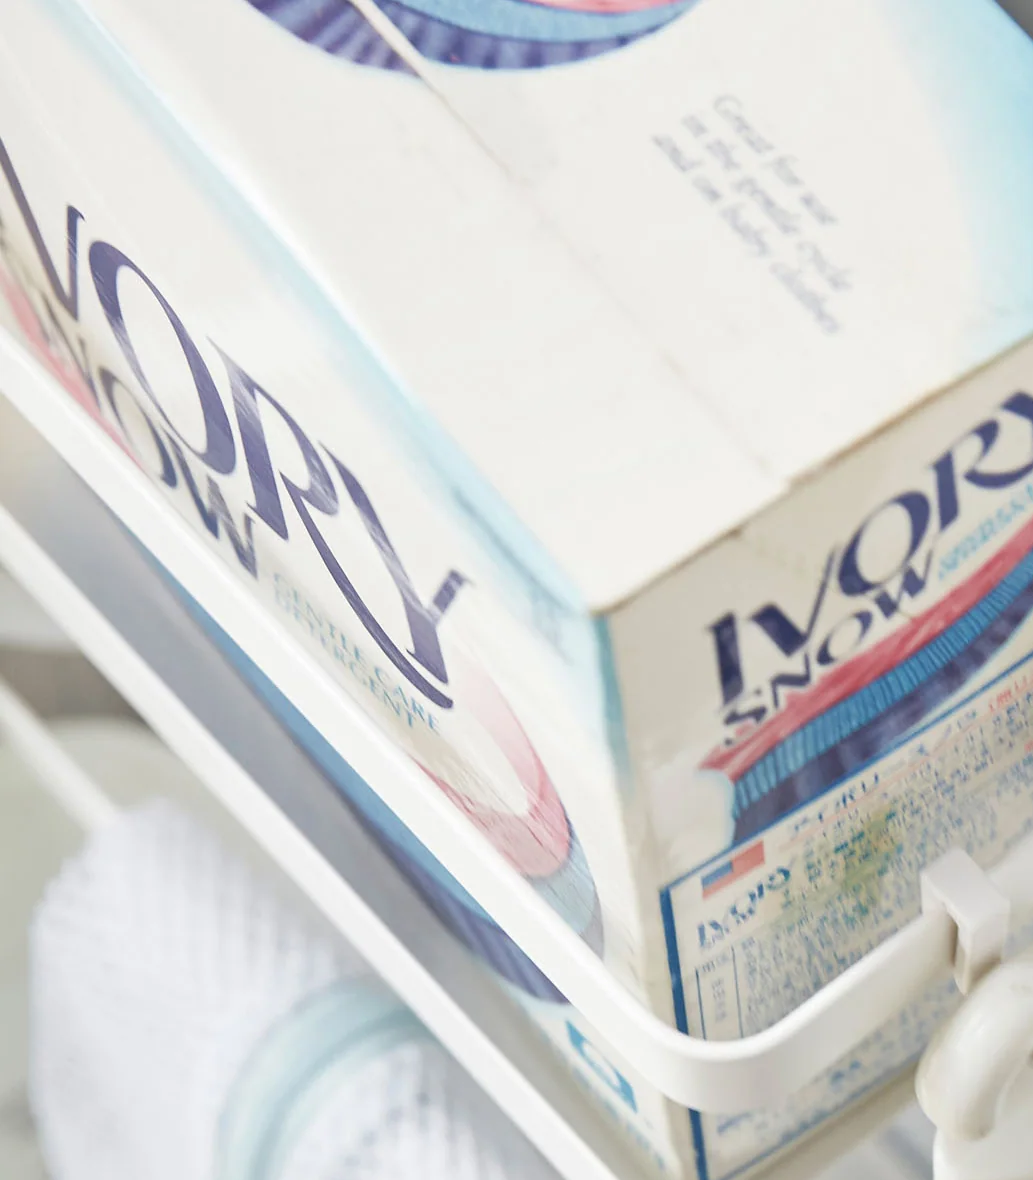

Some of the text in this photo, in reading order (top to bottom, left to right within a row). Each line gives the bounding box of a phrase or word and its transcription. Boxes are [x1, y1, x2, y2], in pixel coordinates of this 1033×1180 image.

[0, 138, 475, 710] VORY
[374, 665, 441, 737] CARE
[722, 530, 938, 747] SNOW
